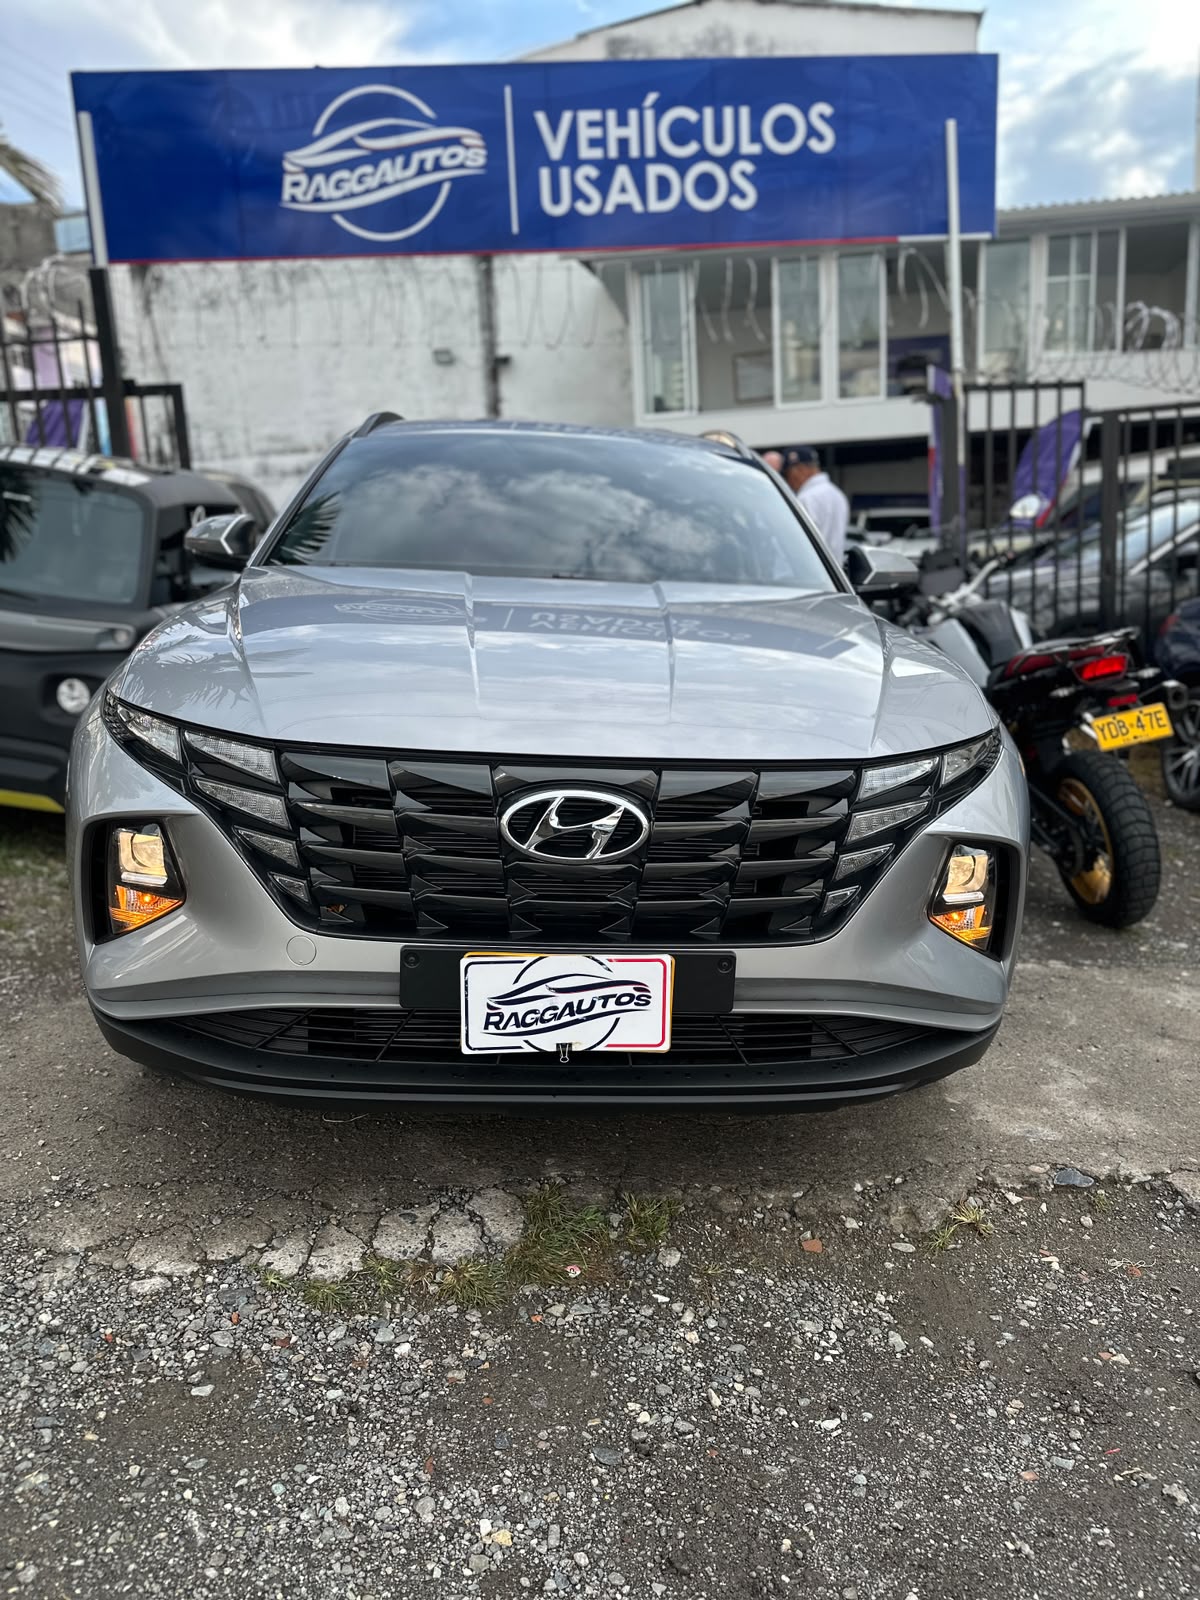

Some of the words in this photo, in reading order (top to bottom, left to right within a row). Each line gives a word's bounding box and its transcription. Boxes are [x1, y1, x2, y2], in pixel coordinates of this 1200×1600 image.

[534, 92, 836, 161] VEHÍCULOS
[281, 145, 487, 203] RAGGAUTOS
[538, 159, 758, 217] USADOS
[483, 992, 652, 1031] RAGGAUTOS
